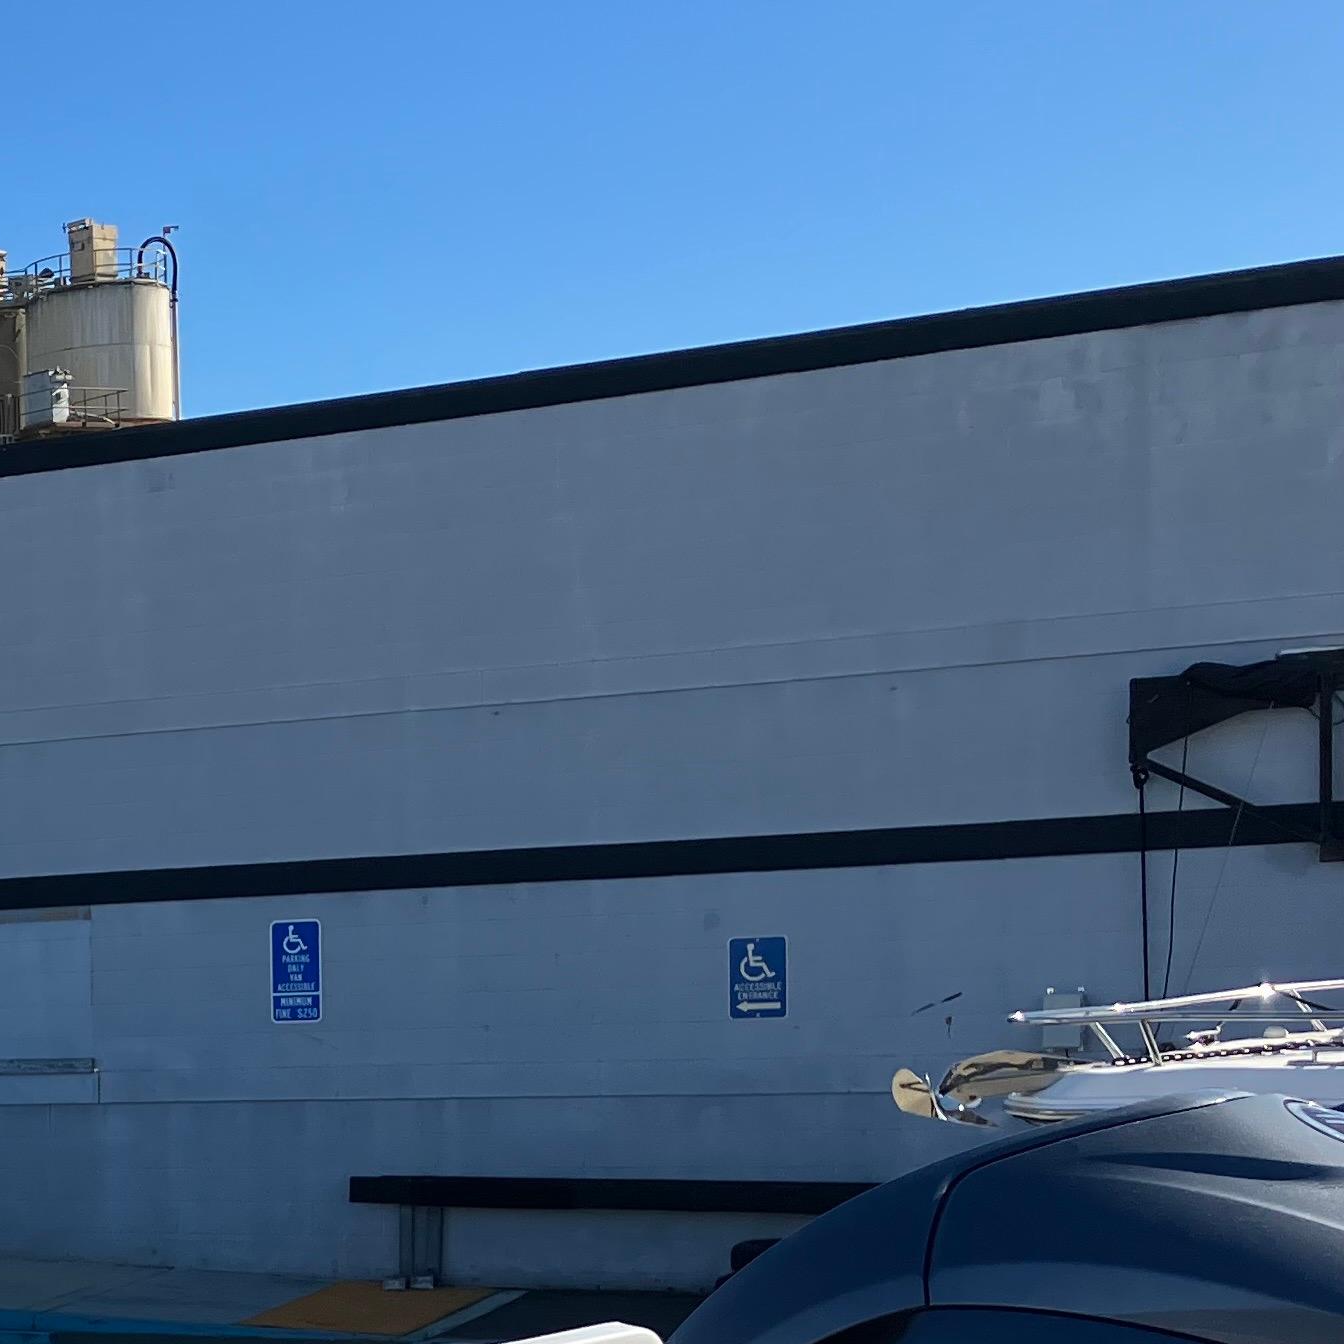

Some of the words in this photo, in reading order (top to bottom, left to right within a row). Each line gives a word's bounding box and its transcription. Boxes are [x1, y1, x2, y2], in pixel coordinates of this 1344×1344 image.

[282, 954, 310, 964] PARKING
[289, 973, 303, 982] VAN
[275, 1008, 292, 1019] FINE
[297, 1008, 318, 1019] $250
